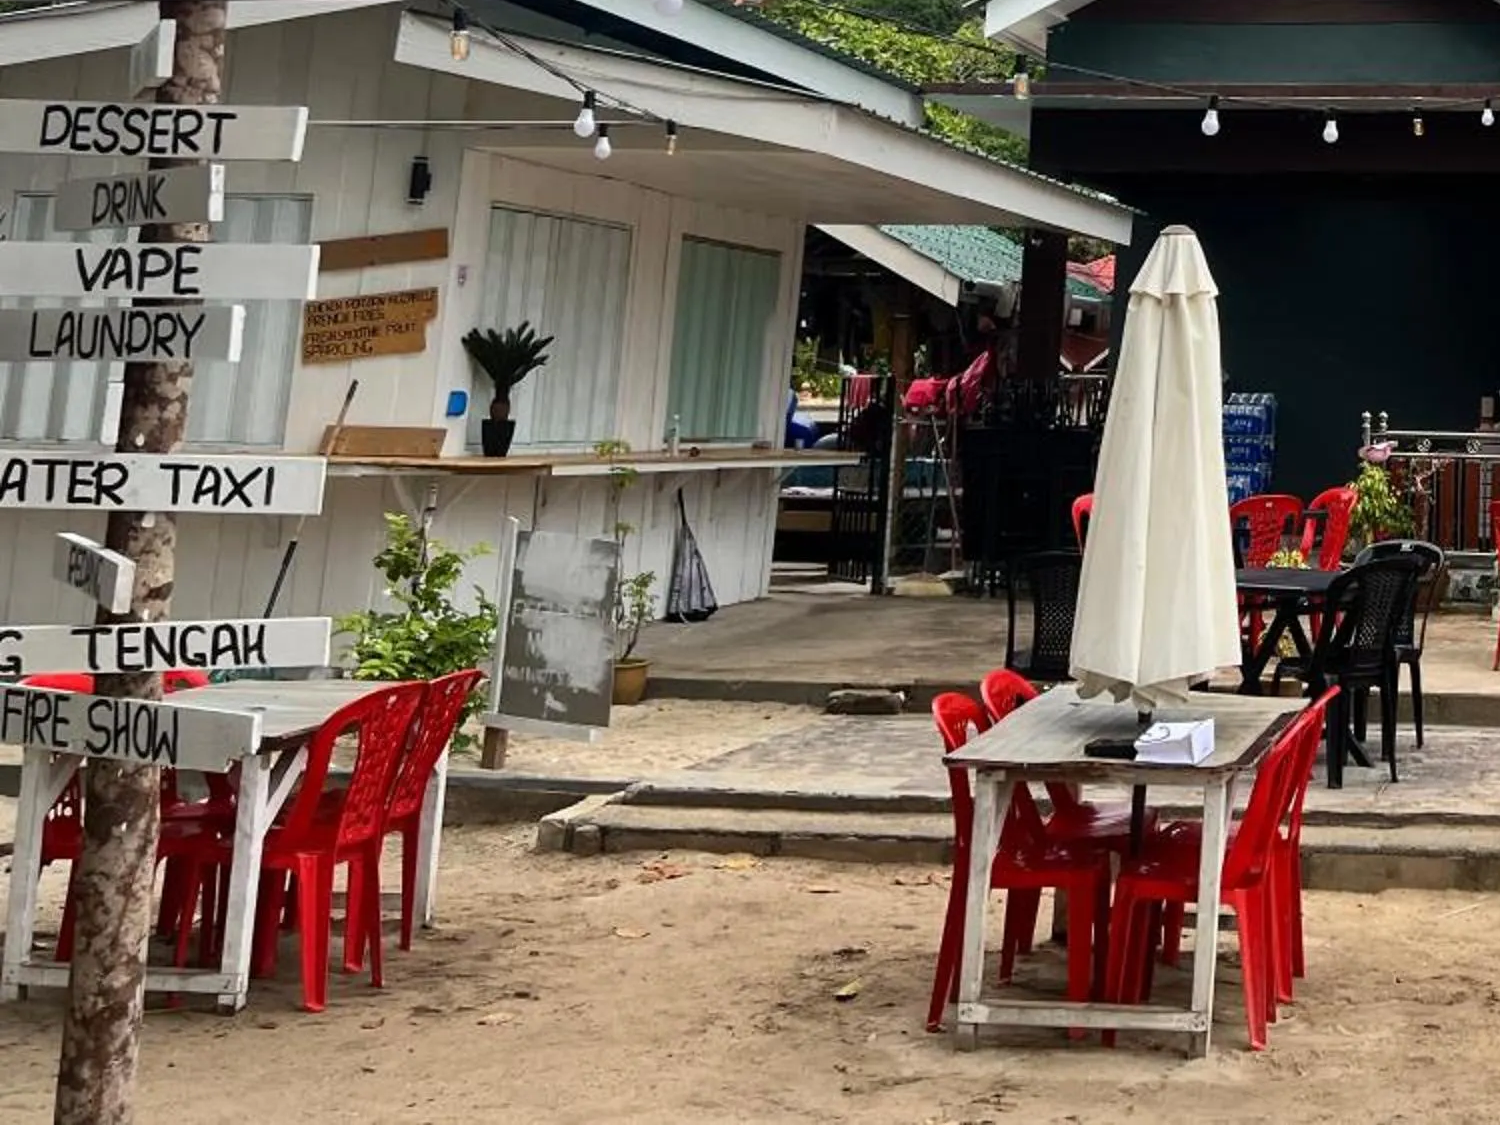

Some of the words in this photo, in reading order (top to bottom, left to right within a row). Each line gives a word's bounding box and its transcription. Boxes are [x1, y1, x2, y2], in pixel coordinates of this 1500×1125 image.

[40, 104, 237, 155] DESSERT
[92, 176, 167, 225] DRINK
[76, 245, 202, 294] VAPE
[29, 310, 206, 359] LAUNDRY
[0, 458, 129, 506] ATER
[160, 462, 275, 508] TAXI
[71, 624, 268, 672] TENGAH
[1, 688, 71, 748] FIRE
[85, 698, 179, 766] SHOW
